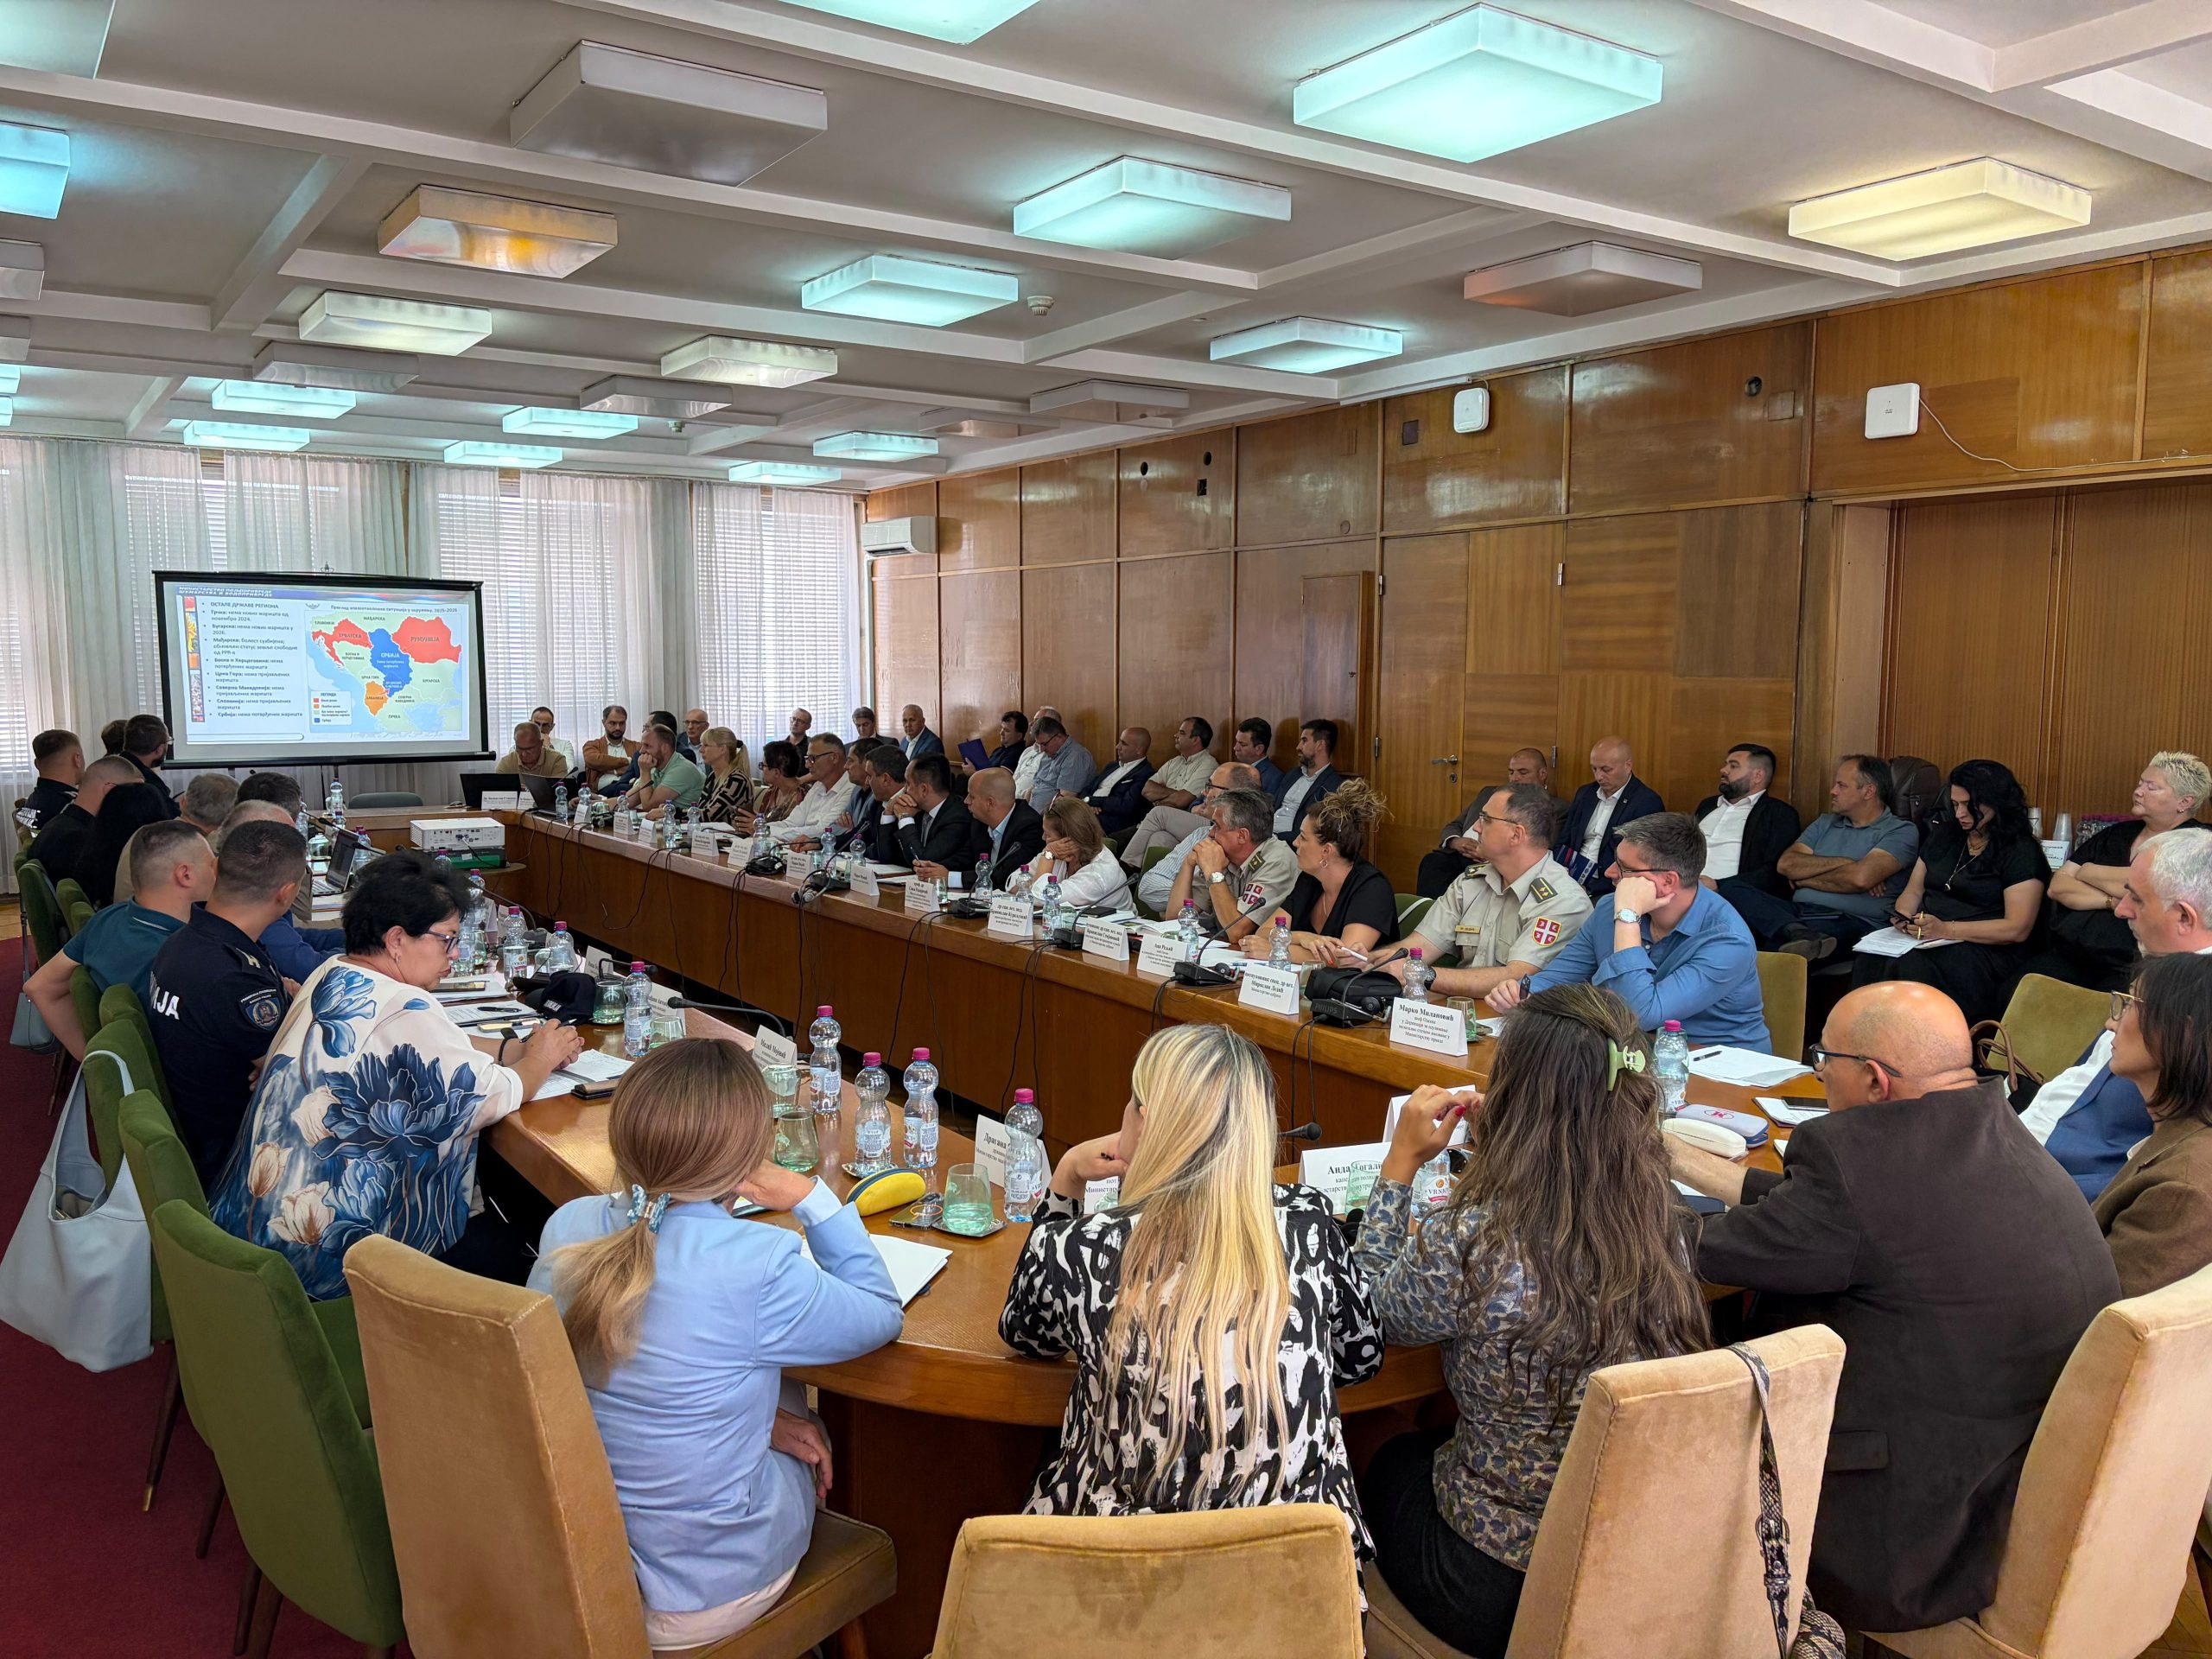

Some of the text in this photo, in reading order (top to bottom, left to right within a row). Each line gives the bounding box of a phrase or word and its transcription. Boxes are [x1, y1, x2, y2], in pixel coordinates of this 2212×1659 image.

[1315, 1003, 1338, 1014] PHILIPS
[1399, 1004, 1454, 1021] Марко Милановић
[984, 1132, 1007, 1149] Драгана
